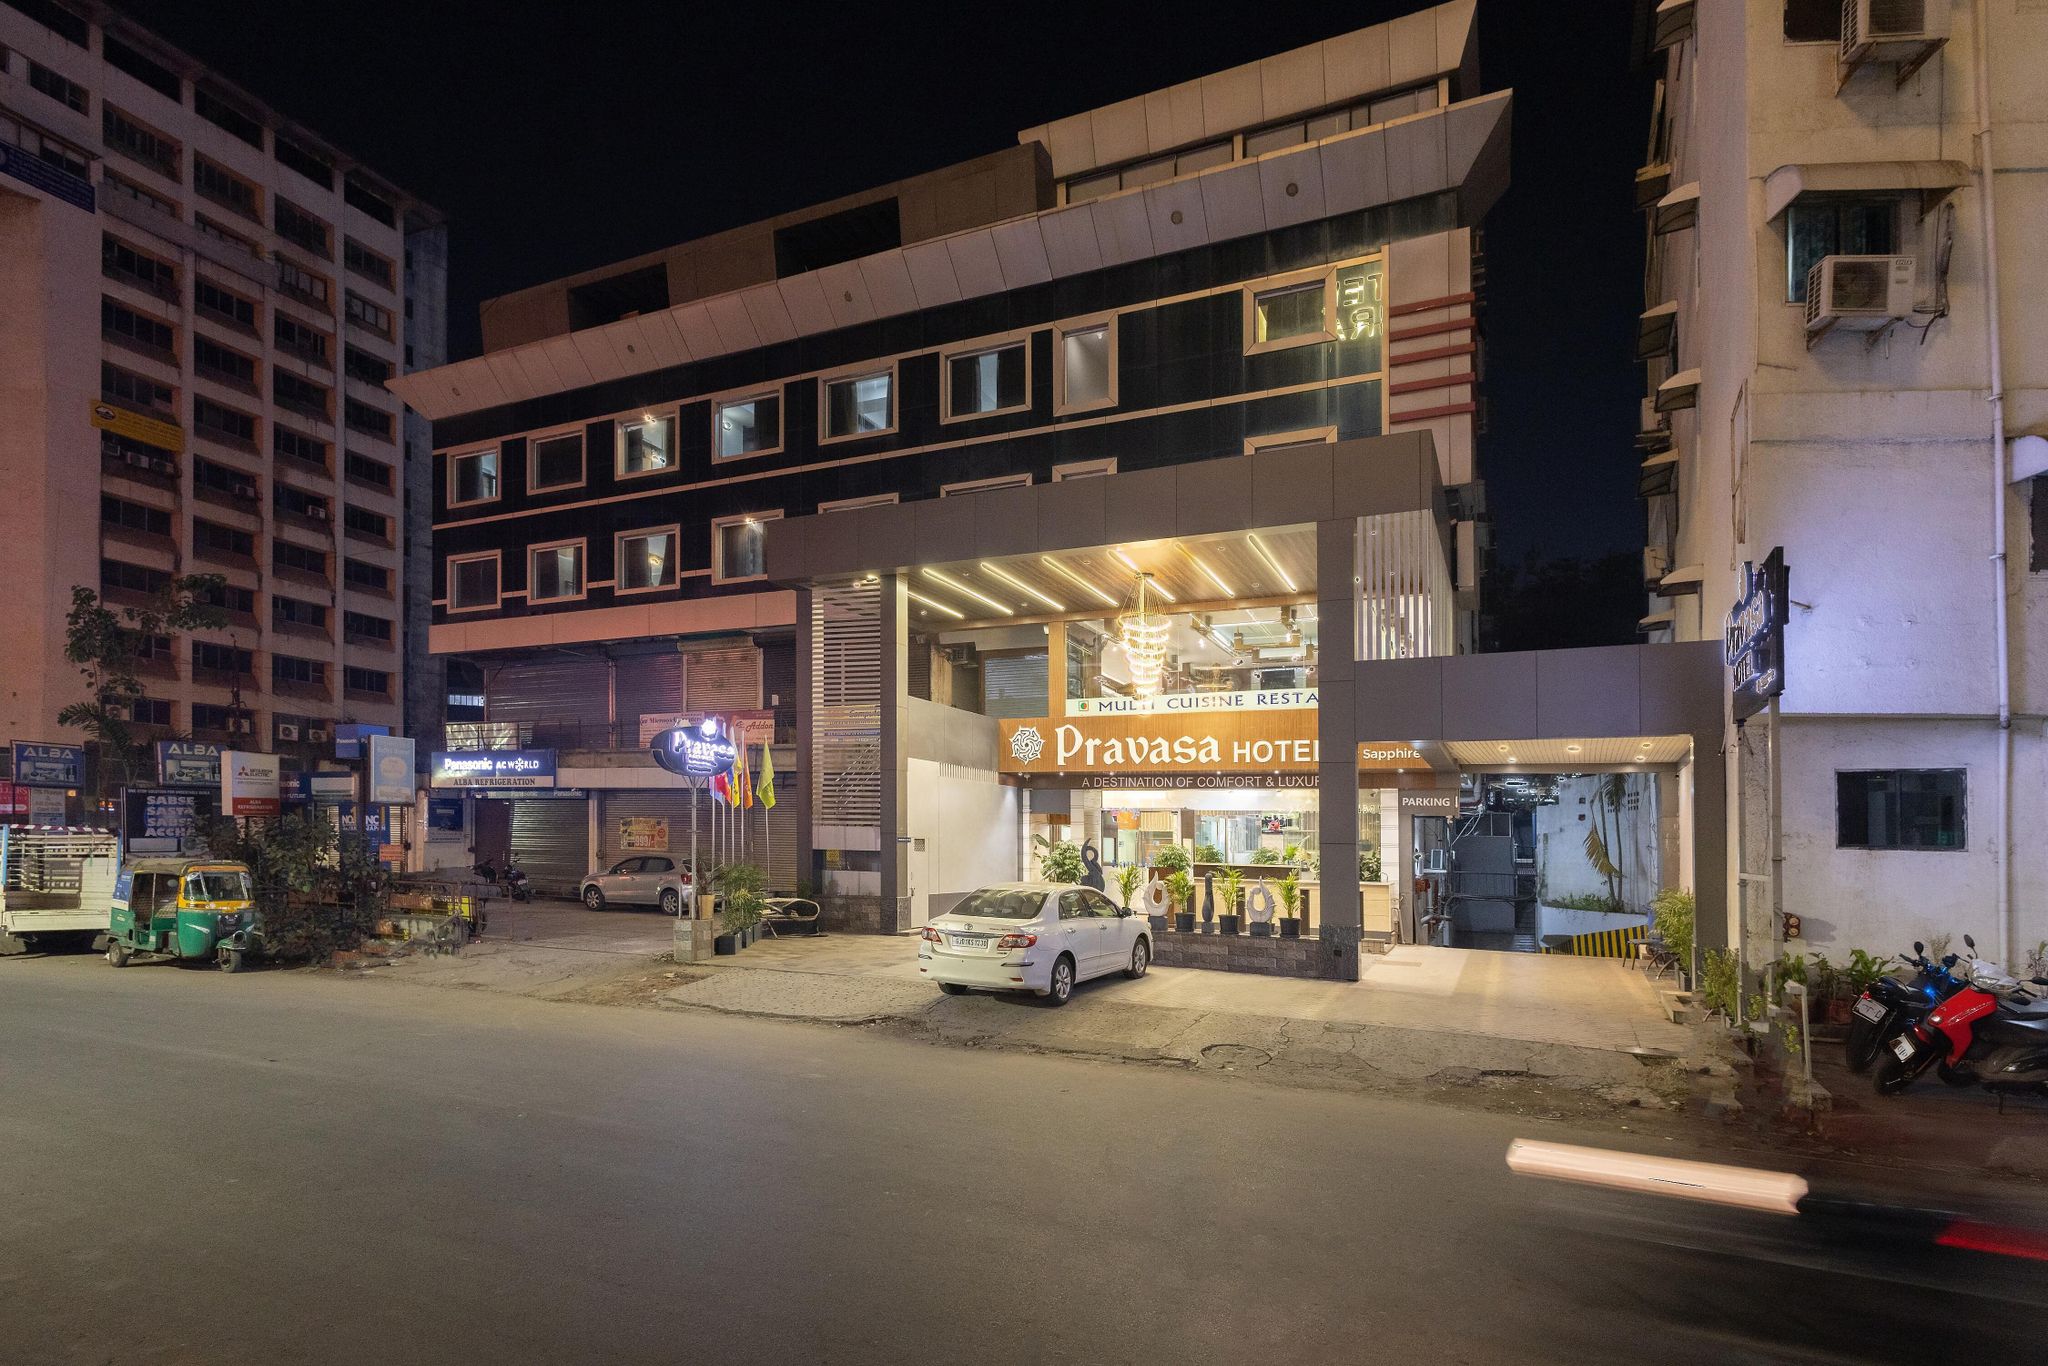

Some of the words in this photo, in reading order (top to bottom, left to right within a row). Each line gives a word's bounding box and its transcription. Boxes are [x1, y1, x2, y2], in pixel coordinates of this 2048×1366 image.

[1167, 694, 1244, 708] CUISINE
[1257, 692, 1319, 706] RESTA
[746, 721, 773, 732] Addon
[168, 743, 219, 756] ALBA
[1054, 724, 1221, 766] Pravasa
[23, 746, 74, 759] ALBA
[1363, 748, 1420, 761] Sapphire
[444, 757, 493, 770] Panasonic
[496, 760, 506, 769] AC
[475, 778, 536, 786] REFRIGERATION
[1082, 777, 1090, 787] A
[1094, 777, 1172, 787] DESTINATION
[1176, 777, 1193, 787] OF
[1197, 776, 1262, 788] COMFORT
[1265, 776, 1274, 788] &
[146, 795, 195, 805] SABSE
[1402, 797, 1450, 807] PARKING
